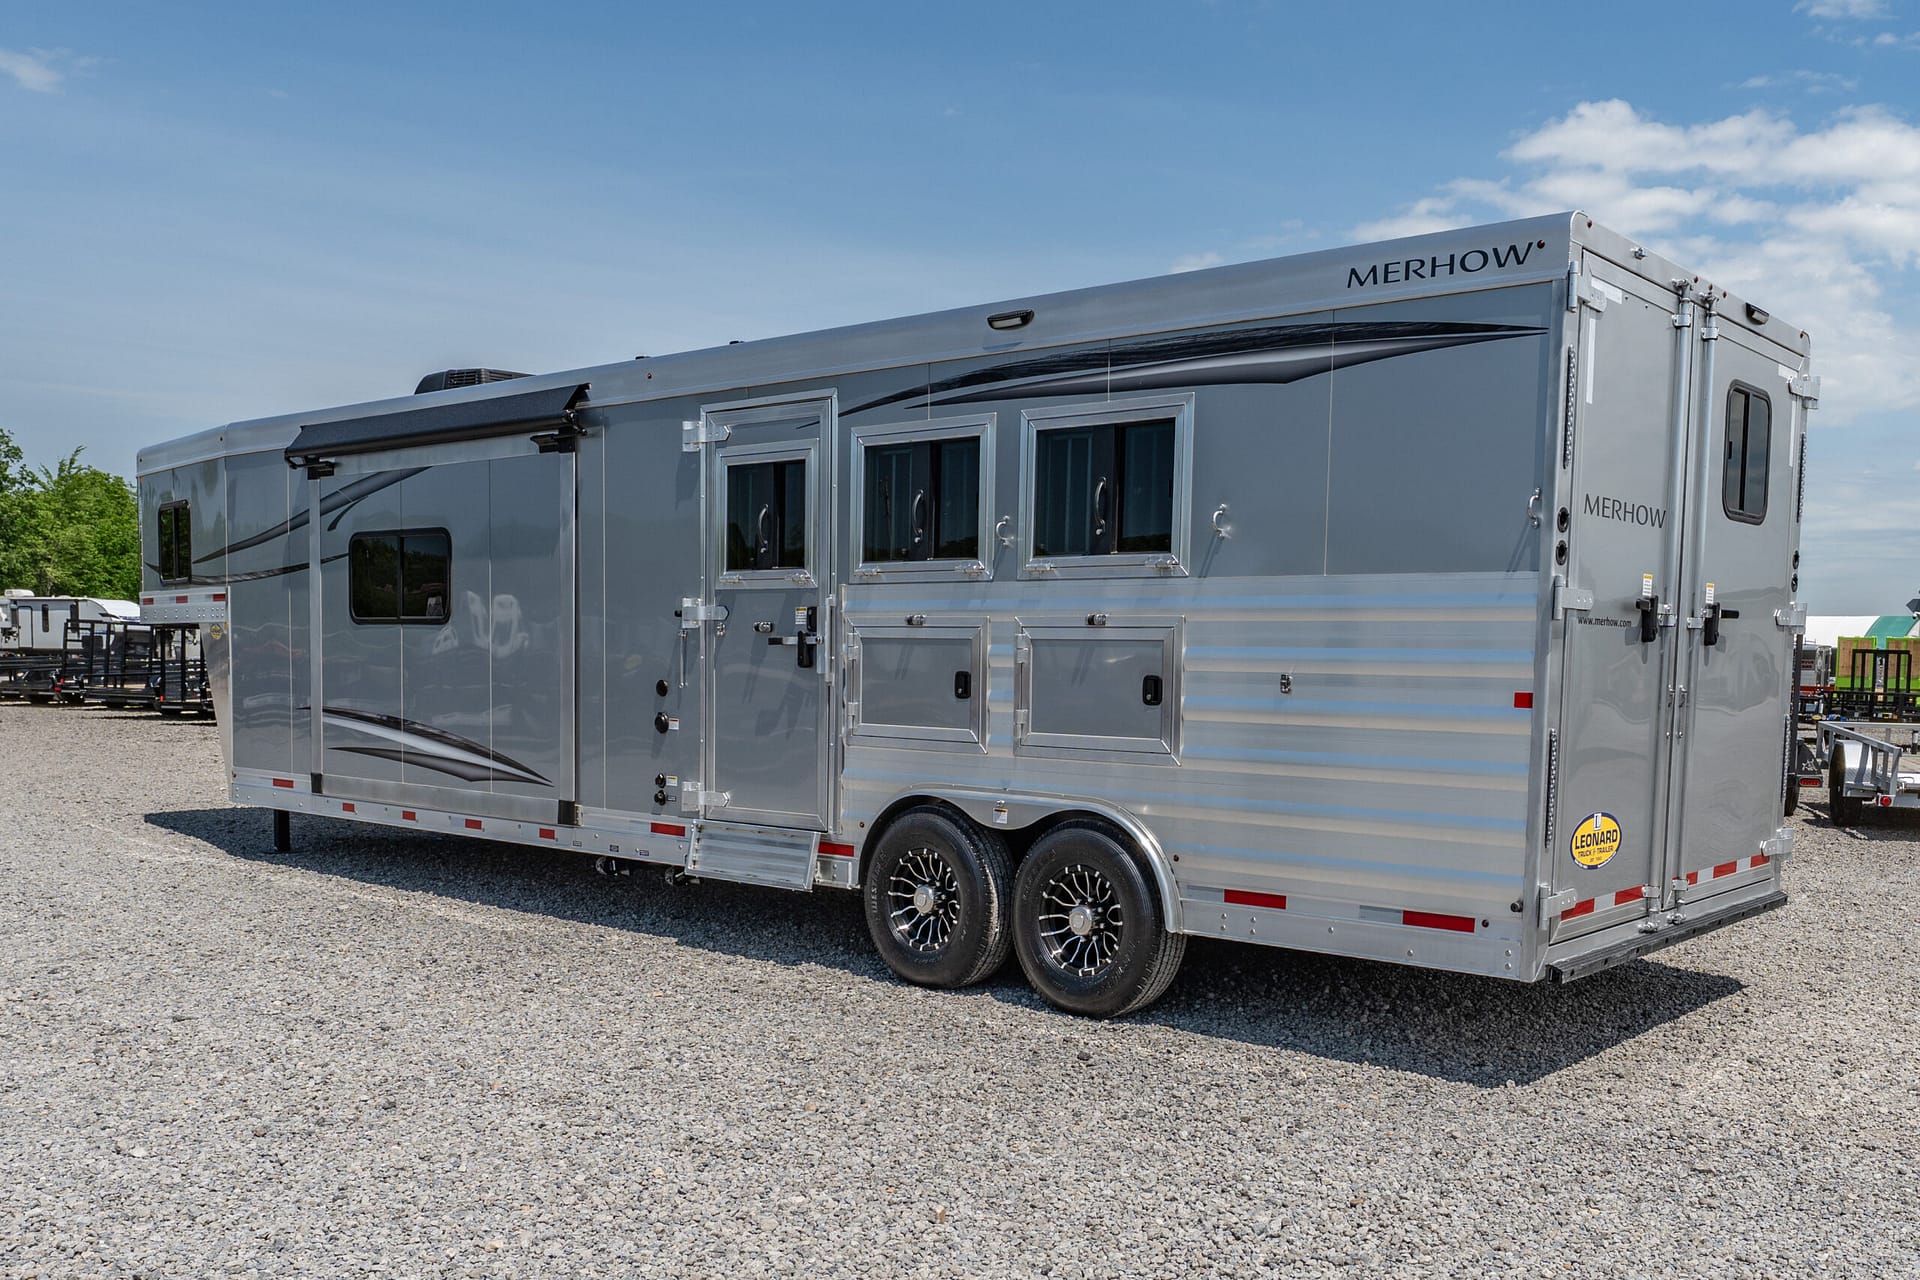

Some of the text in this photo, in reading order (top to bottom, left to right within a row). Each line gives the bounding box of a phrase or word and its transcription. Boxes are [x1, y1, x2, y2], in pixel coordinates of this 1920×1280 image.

[1347, 241, 1534, 289] MERHOW
[1584, 493, 1667, 529] MERHOW
[1578, 615, 1632, 628] www.merhow.com
[1575, 829, 1618, 849] LEONARD
